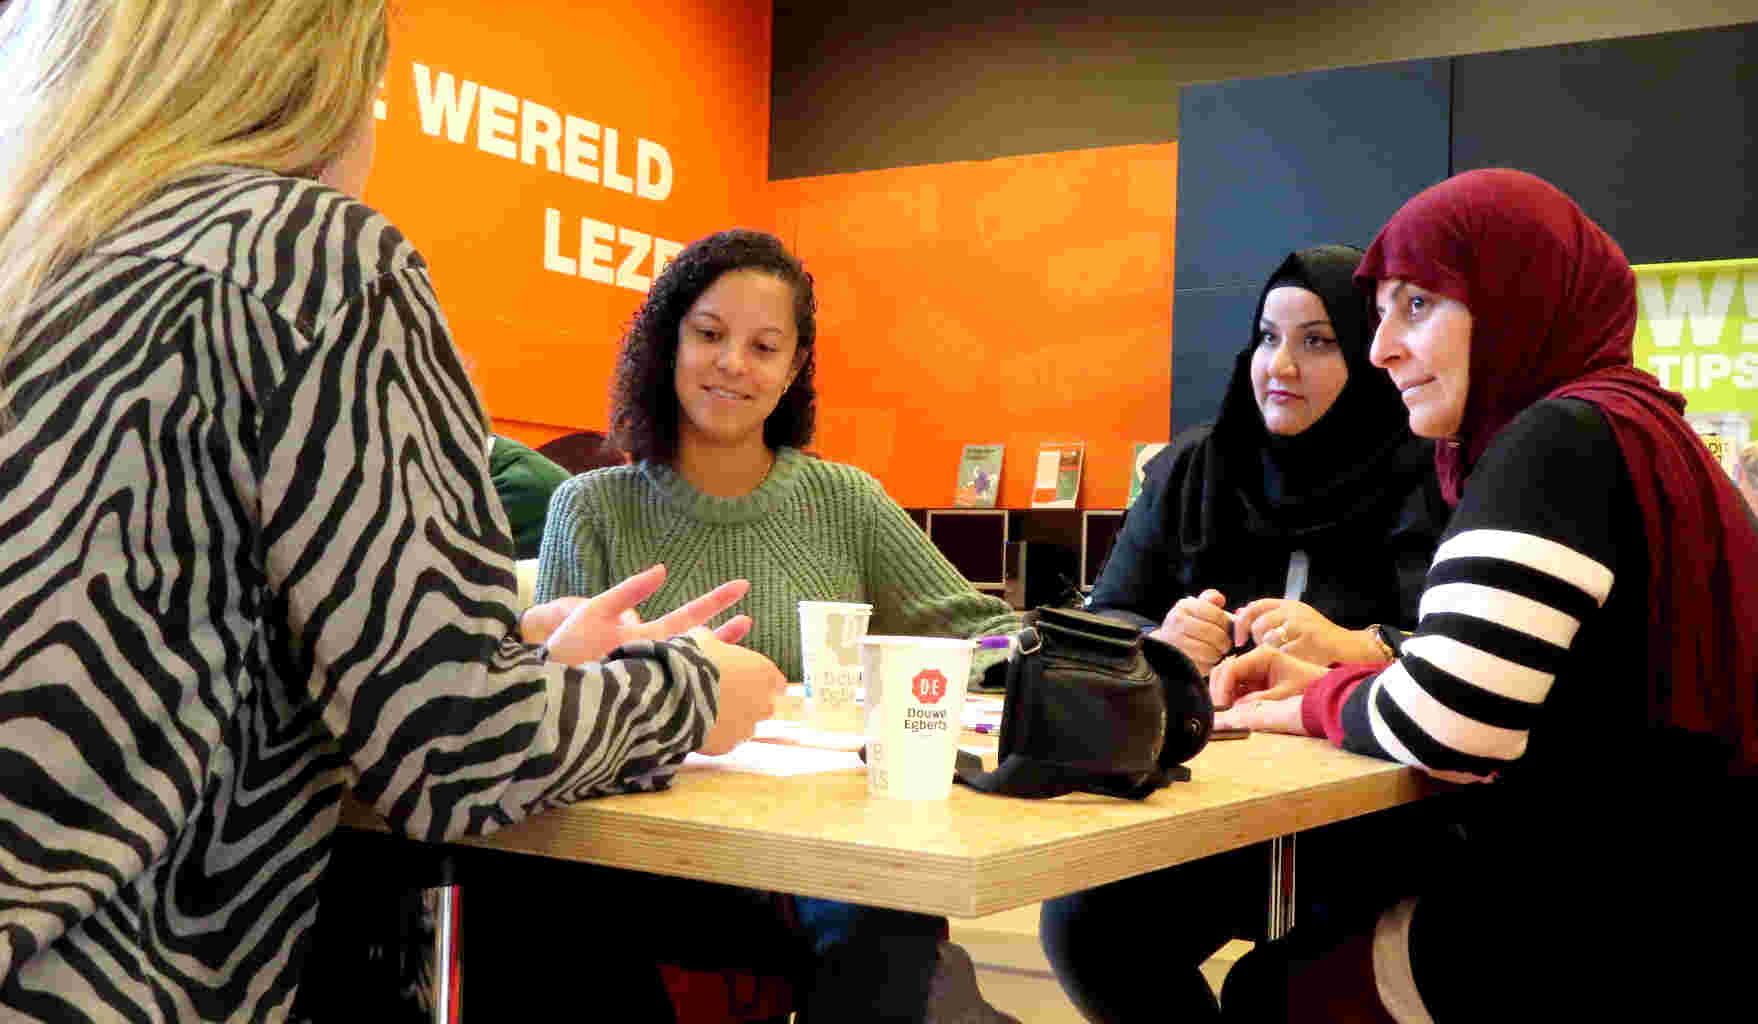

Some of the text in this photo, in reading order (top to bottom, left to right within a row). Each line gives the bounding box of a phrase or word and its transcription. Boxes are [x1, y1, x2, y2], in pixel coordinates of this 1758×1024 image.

[412, 61, 673, 201] WERELD
[906, 706, 948, 720] Douwe
[904, 719, 949, 733] Egberts
